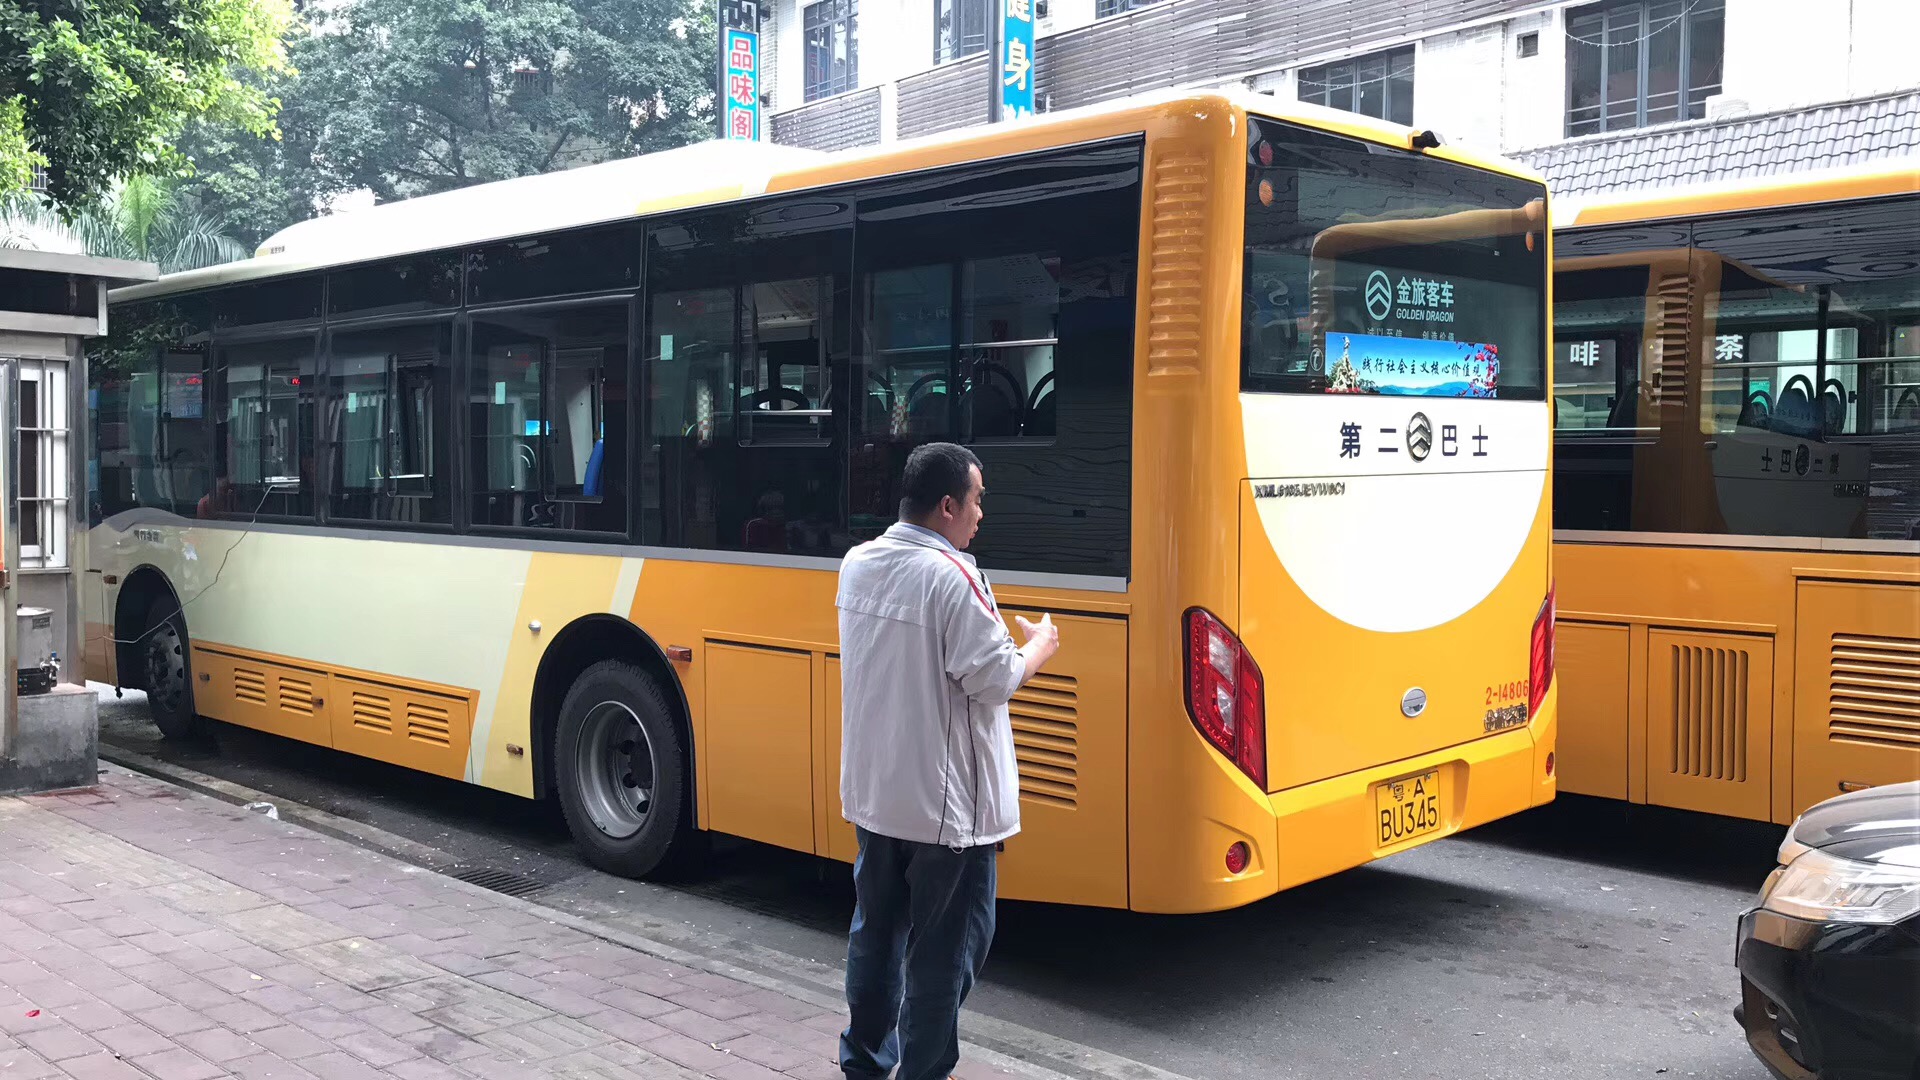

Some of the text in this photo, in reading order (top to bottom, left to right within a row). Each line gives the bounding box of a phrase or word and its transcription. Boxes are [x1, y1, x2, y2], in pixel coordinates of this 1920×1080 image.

[730, 38, 754, 140] 品味阁
[1396, 276, 1454, 308] 金旅客车
[1396, 308, 1454, 323] GOLDEN DRAGON
[1569, 340, 1600, 367] 啡
[1714, 334, 1744, 361] 茶
[1361, 355, 1482, 378] 践行社会主义核心价值观
[1339, 421, 1489, 459] 第二巴士
[1485, 679, 1529, 706] 2-14806
[1380, 795, 1438, 842] BU345
